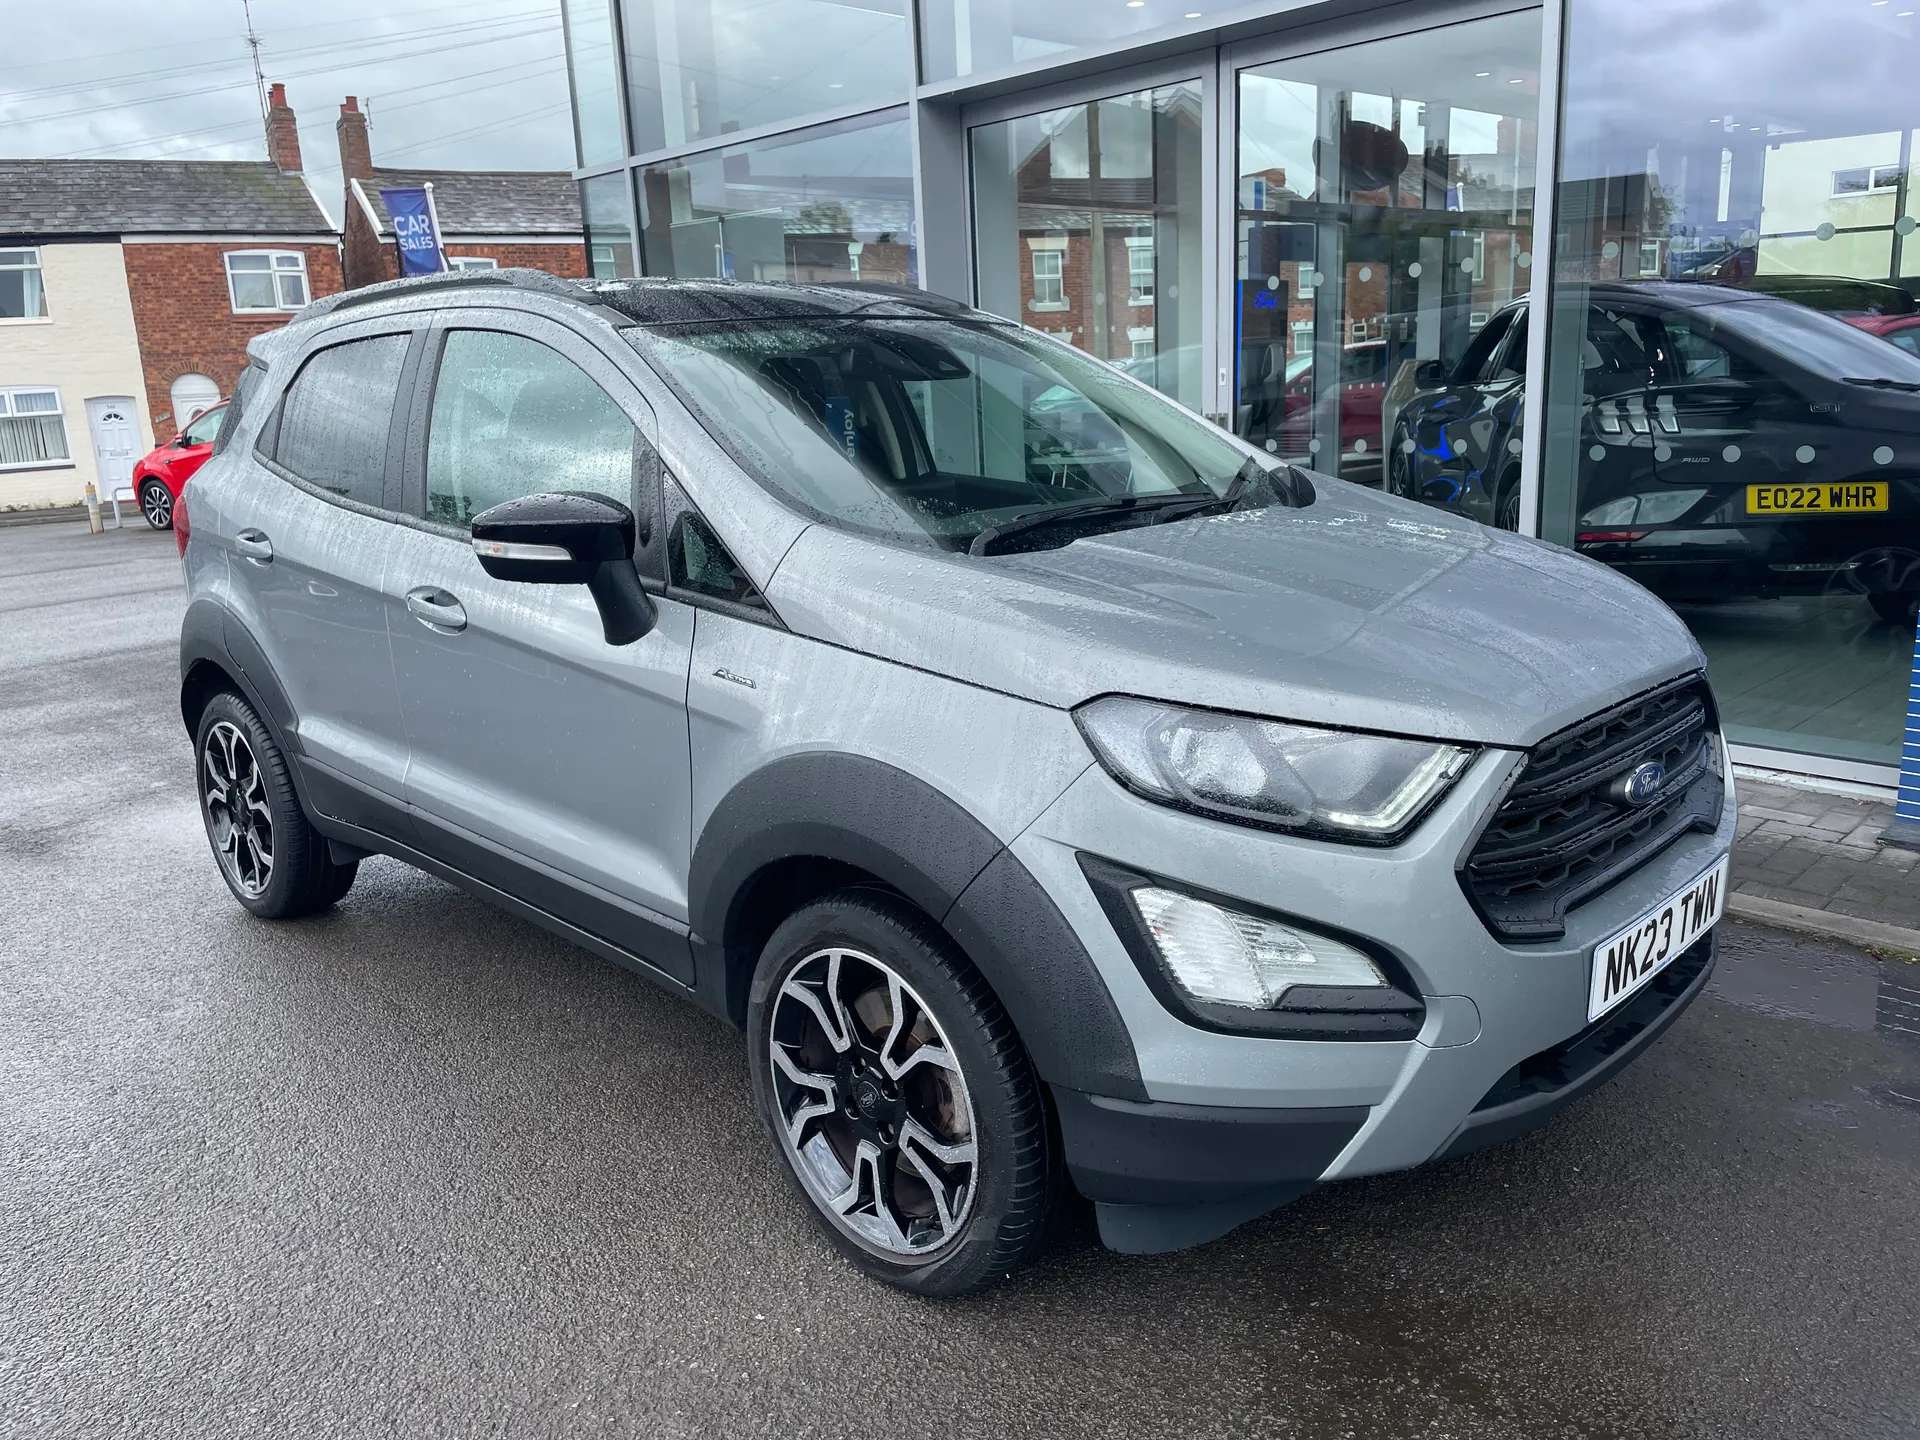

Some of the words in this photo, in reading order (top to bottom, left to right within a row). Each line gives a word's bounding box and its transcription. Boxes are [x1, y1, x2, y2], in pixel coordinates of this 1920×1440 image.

[394, 215, 430, 236] CAR
[400, 237, 433, 251] SALES
[843, 409, 856, 459] enjoy
[1757, 488, 1821, 509] EO22
[1829, 486, 1876, 508] WHR
[1603, 907, 1673, 1002] NK23
[1680, 869, 1720, 944] TWN
